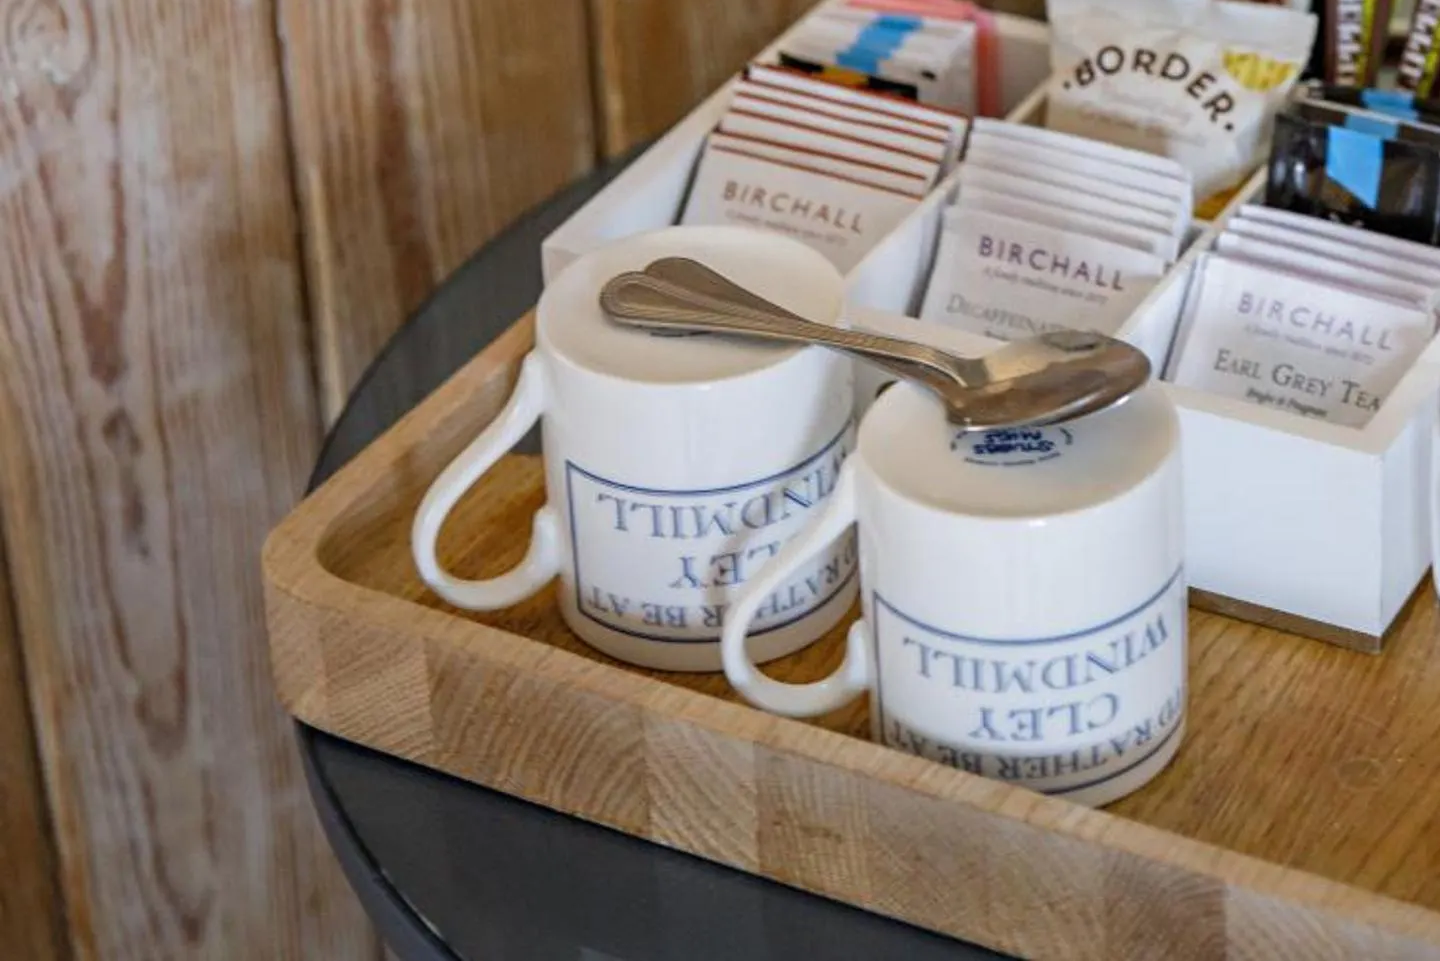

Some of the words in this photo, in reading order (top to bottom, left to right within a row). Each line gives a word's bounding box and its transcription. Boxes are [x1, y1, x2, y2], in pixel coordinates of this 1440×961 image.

[723, 180, 863, 235] BIRCHALL
[978, 236, 1124, 291] BIRCHALL
[1237, 293, 1392, 350] BIRCHALL
[669, 541, 780, 589] LEY
[703, 555, 841, 628] RATHR
[589, 586, 630, 617] AT
[642, 603, 688, 628] BE
[902, 613, 1168, 694] WINDMILL
[969, 692, 1119, 741] CLEY
[999, 717, 1153, 780] RATHER
